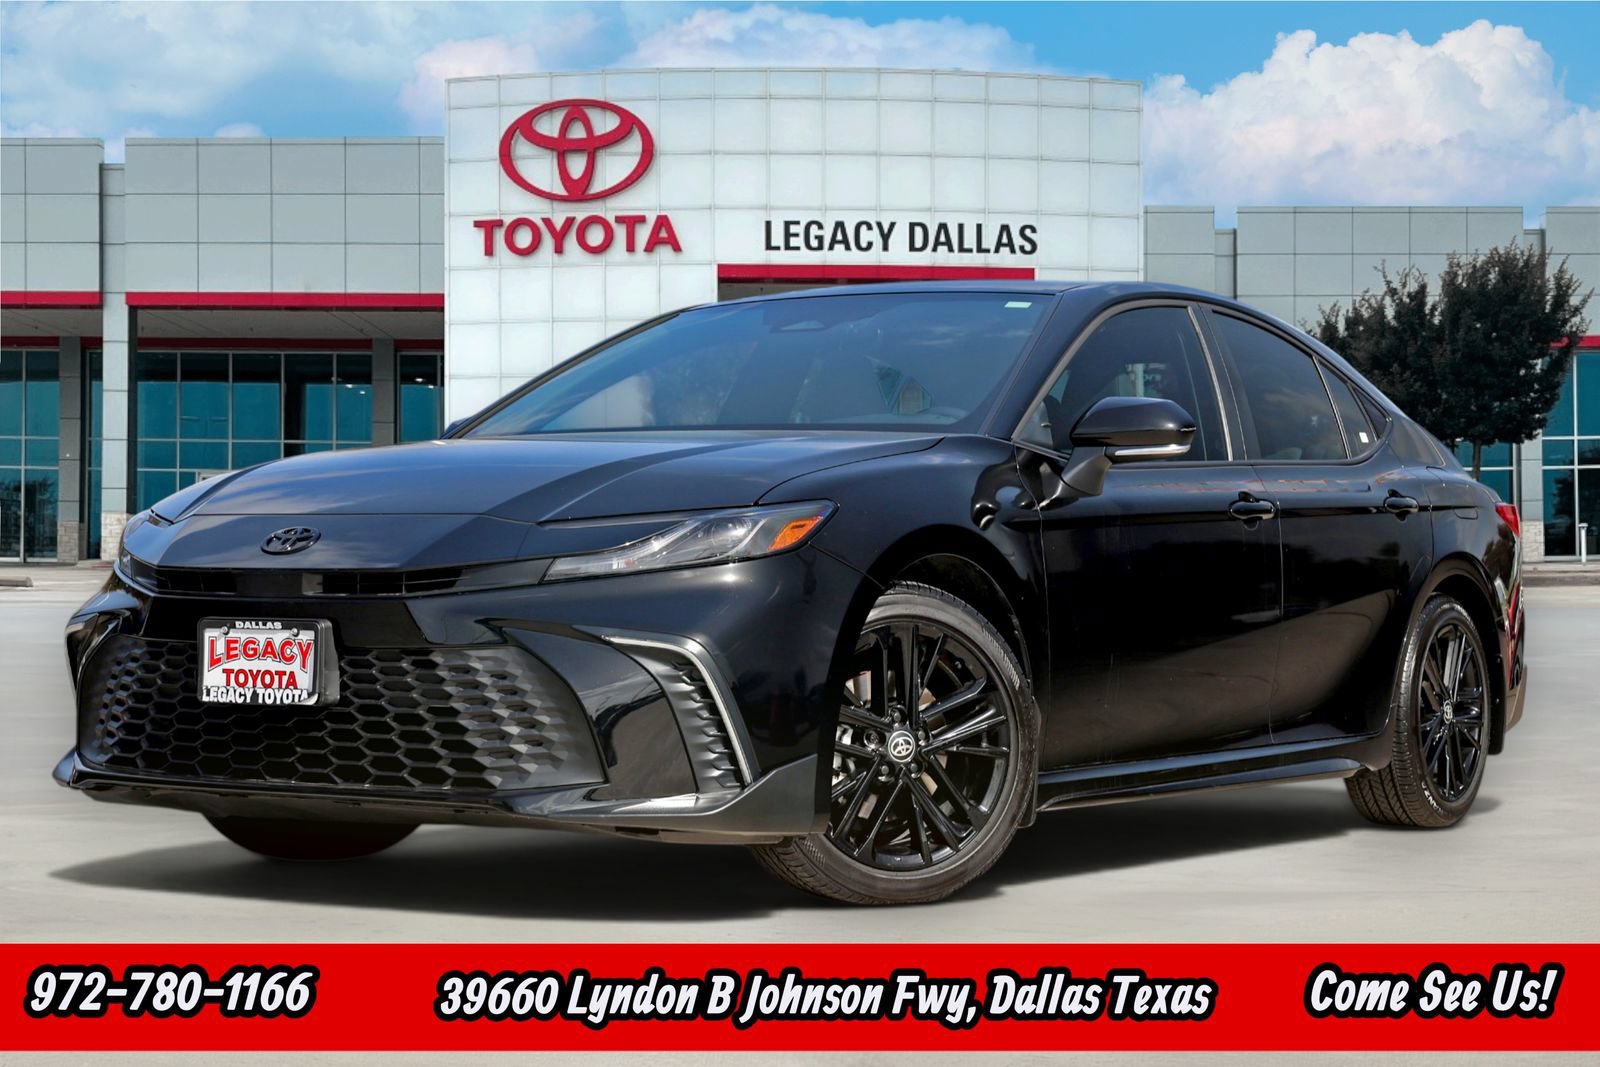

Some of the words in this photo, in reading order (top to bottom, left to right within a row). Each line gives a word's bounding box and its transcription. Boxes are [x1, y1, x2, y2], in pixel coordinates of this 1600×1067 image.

[473, 214, 682, 257] TOYOTA
[764, 221, 896, 252] LEGACY
[908, 222, 1038, 255] DALLAS
[235, 621, 282, 629] DALLAS
[208, 636, 314, 673] LEGACY
[222, 669, 298, 689] TOYOTA
[202, 685, 254, 704] LEGACY
